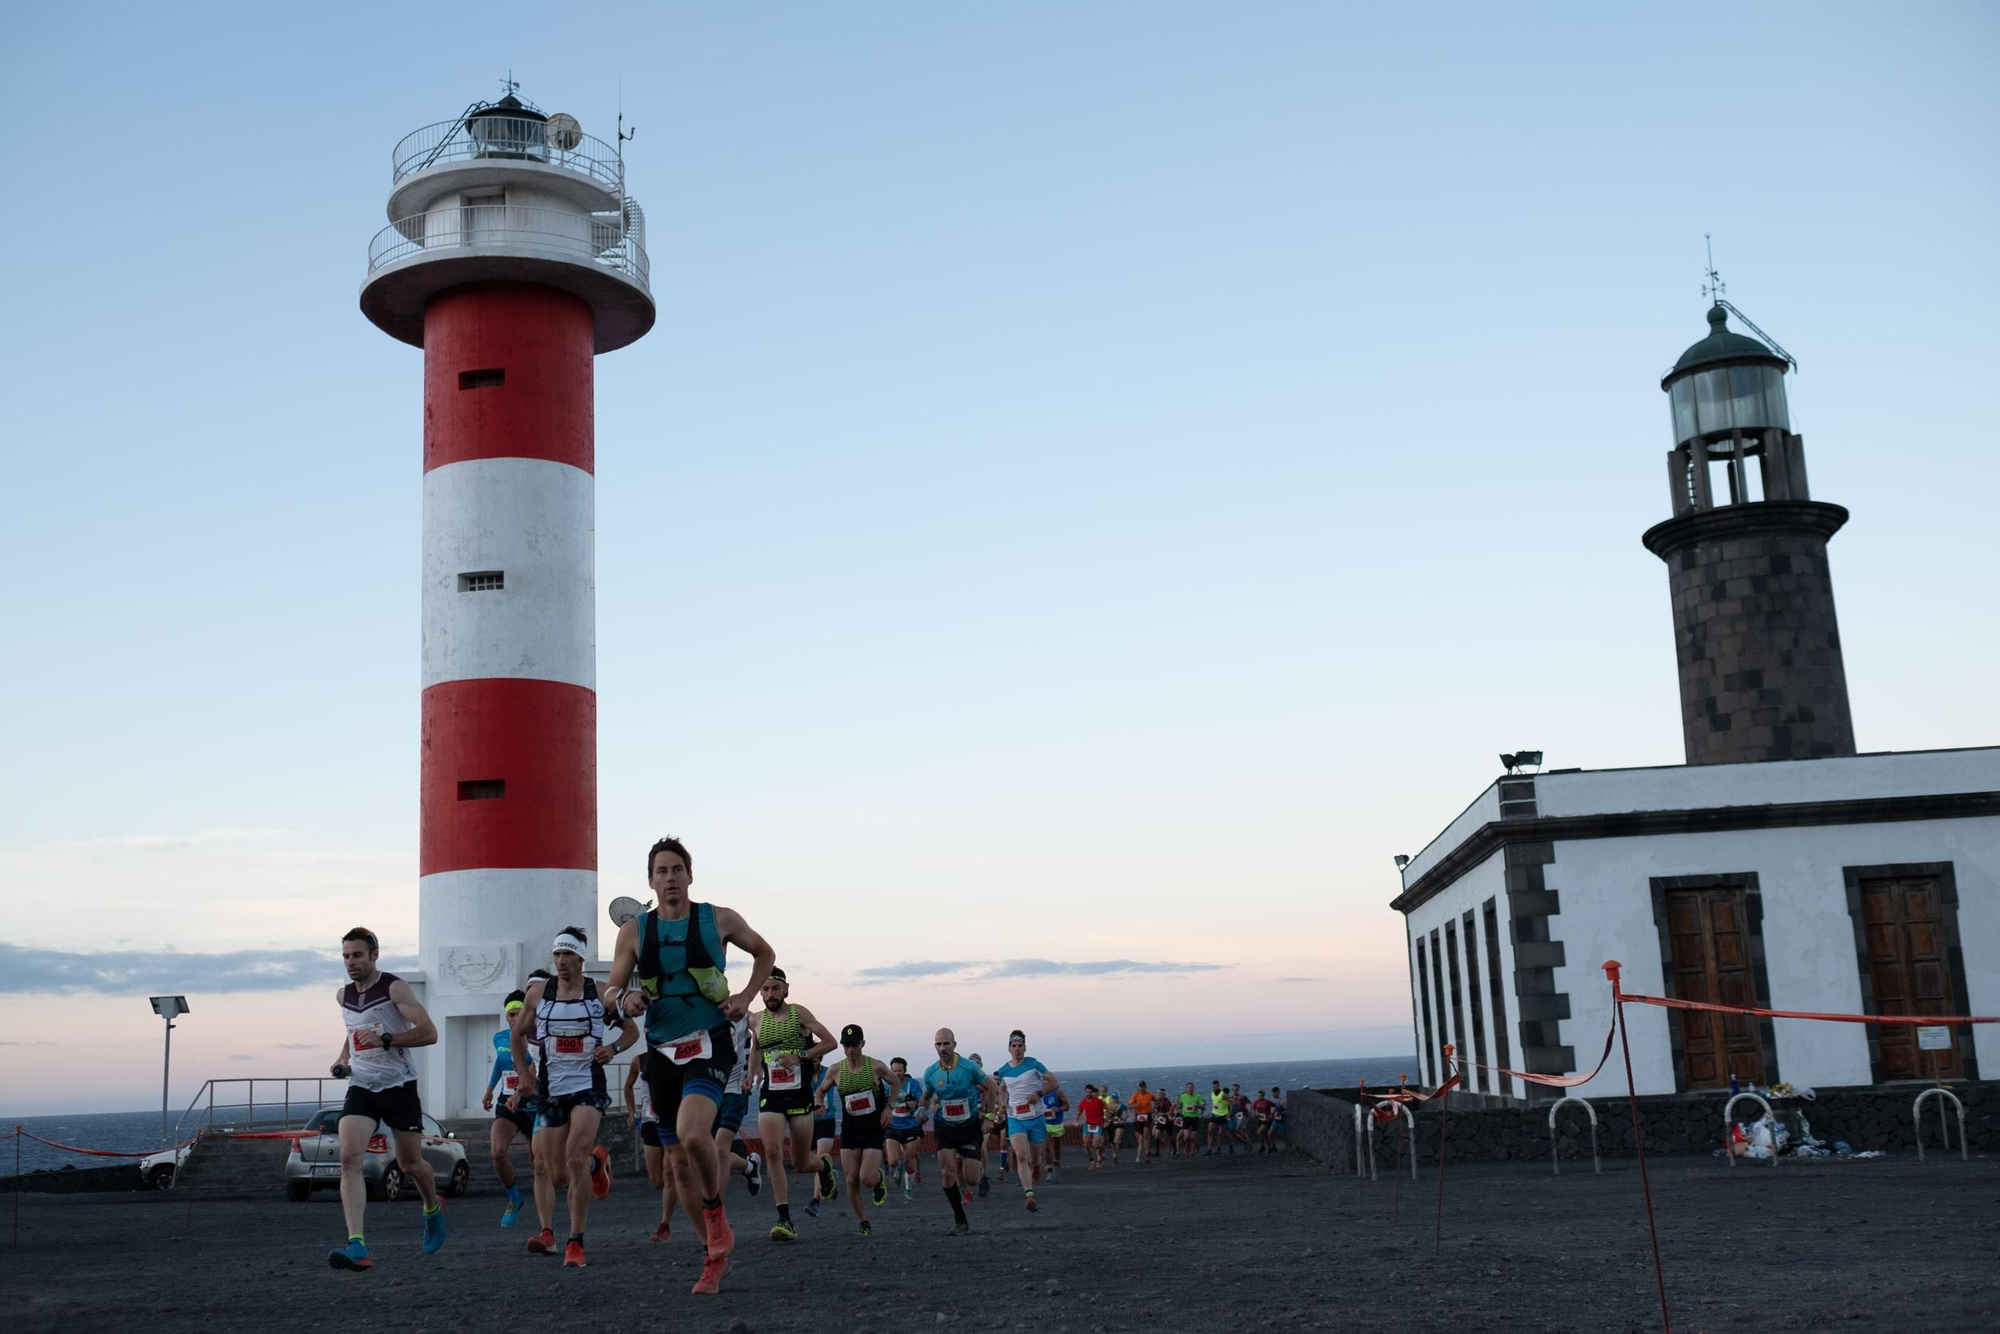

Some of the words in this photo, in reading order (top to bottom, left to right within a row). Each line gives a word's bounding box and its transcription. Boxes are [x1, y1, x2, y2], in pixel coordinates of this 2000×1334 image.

[557, 942, 578, 950] TERREX
[558, 1038, 583, 1048] 3001
[677, 1043, 700, 1056] 506
